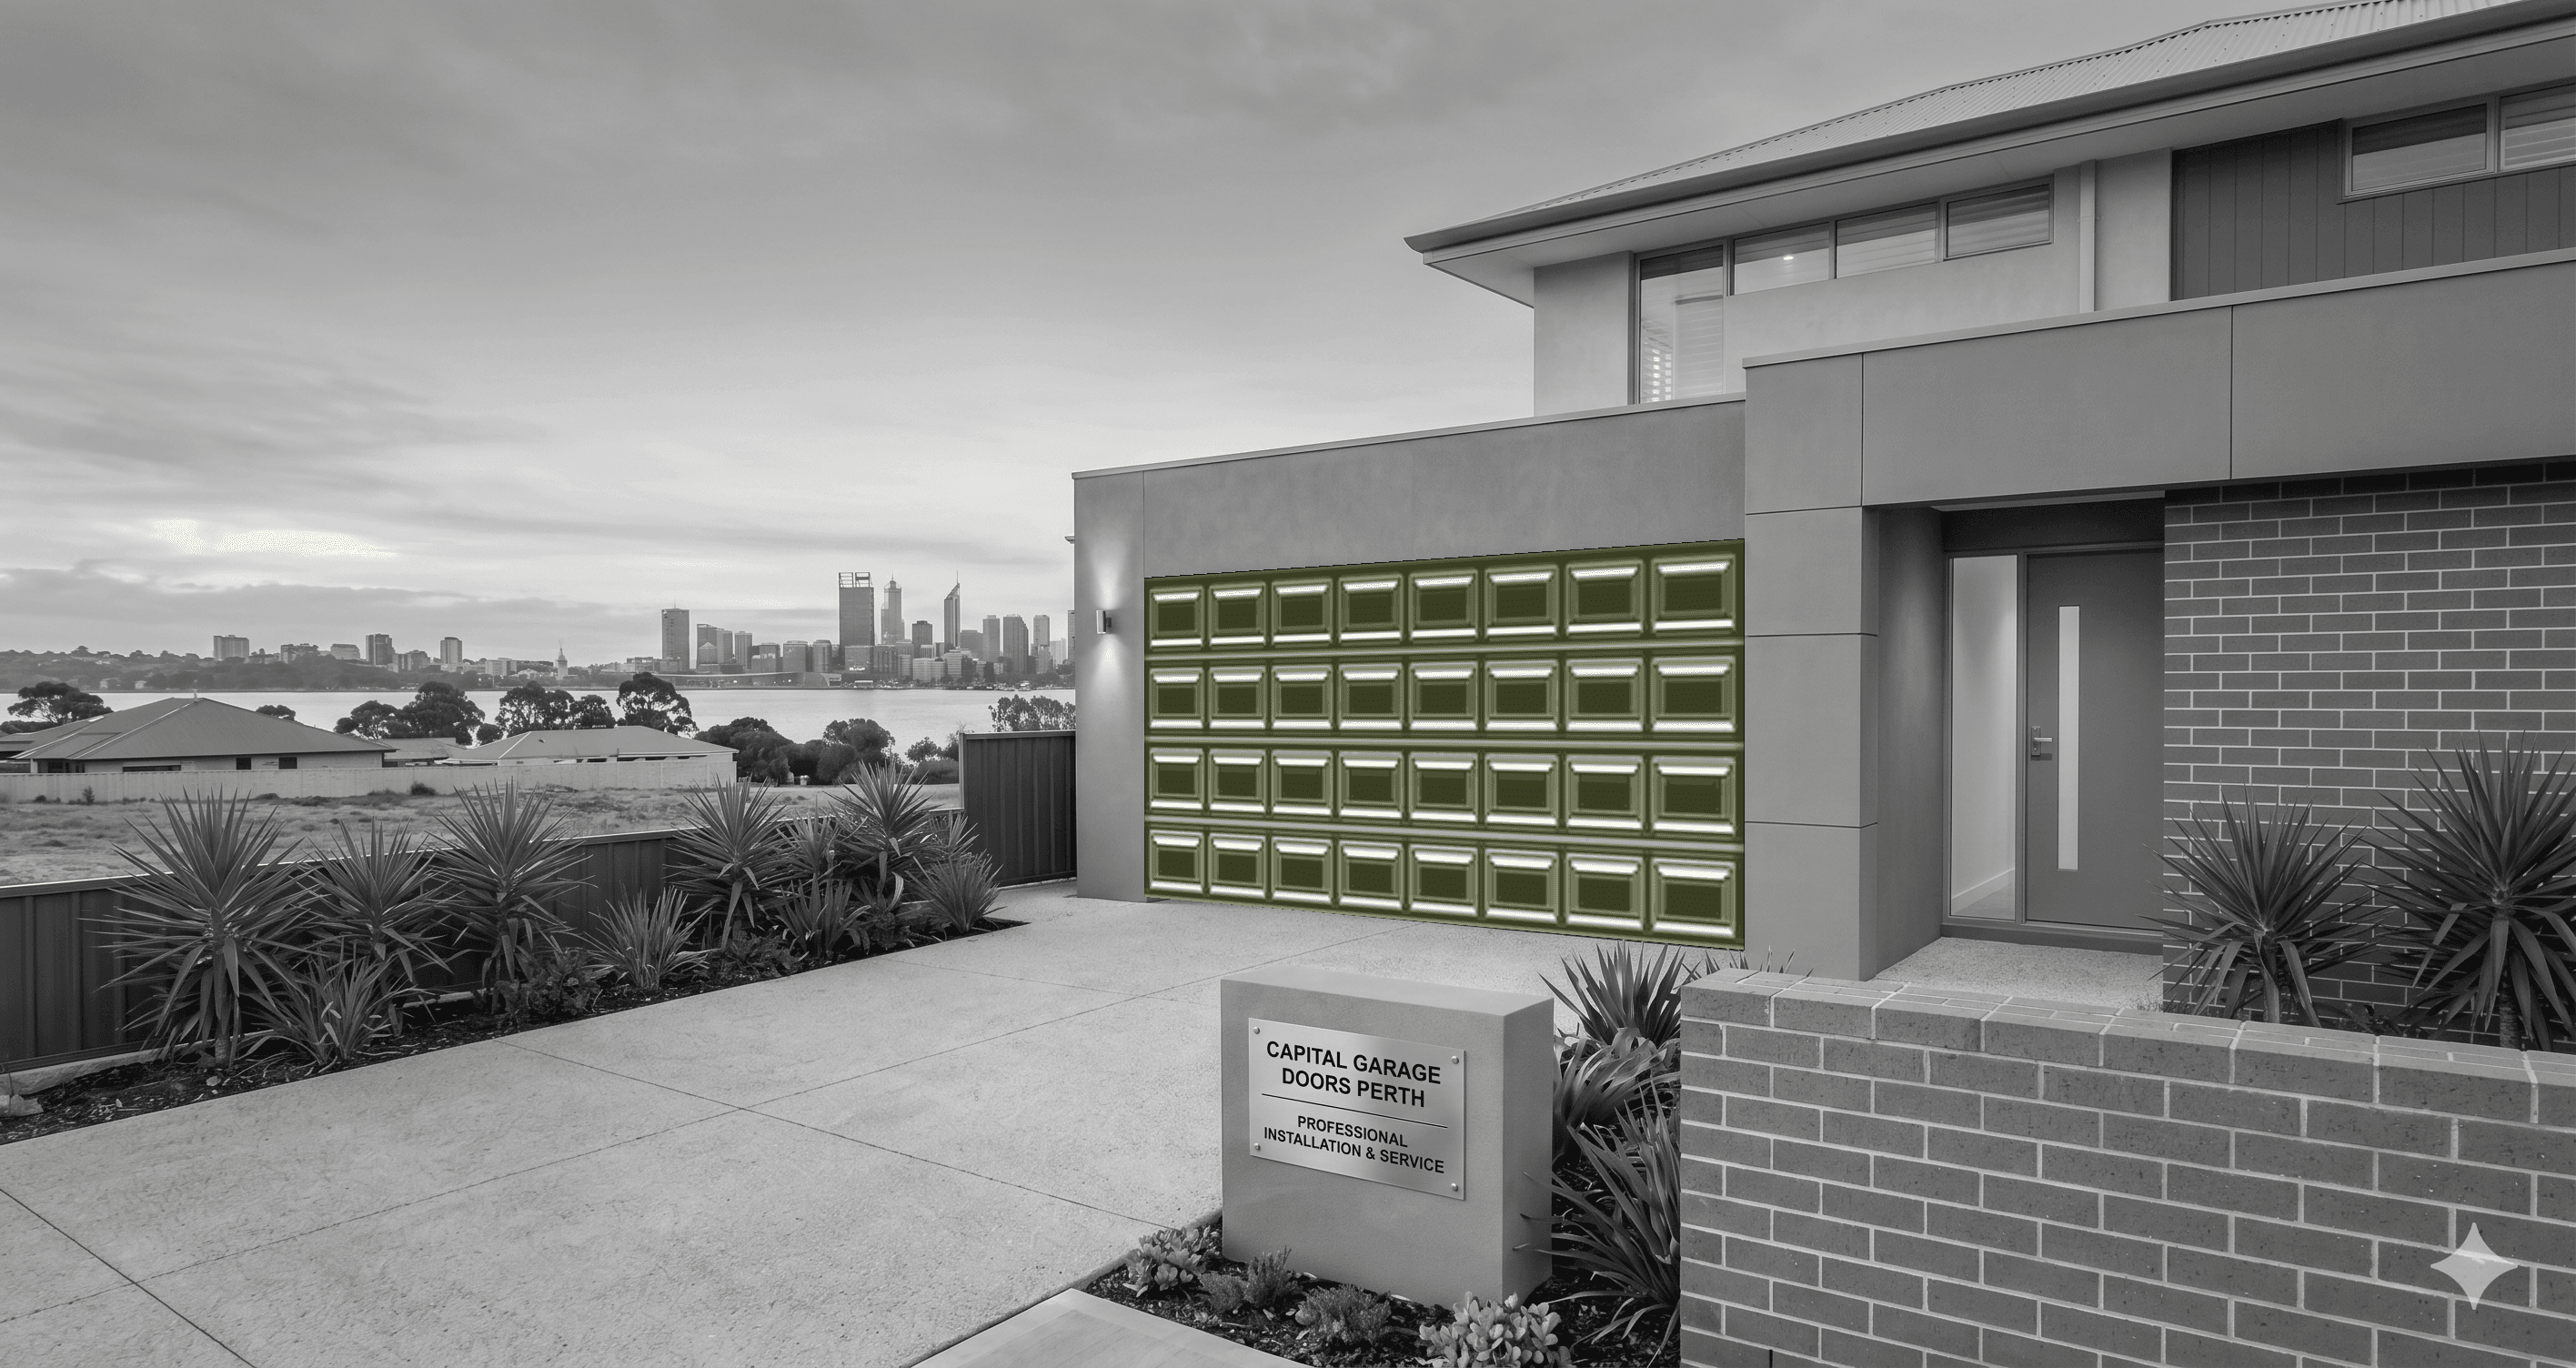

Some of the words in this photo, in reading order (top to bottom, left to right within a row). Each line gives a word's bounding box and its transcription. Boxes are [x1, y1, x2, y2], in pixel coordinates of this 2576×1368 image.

[1266, 1041, 1348, 1070] CAPITAL
[1353, 1054, 1441, 1085] GARAGE
[1282, 1067, 1351, 1095] DOORS
[1357, 1080, 1424, 1108] PERTH
[1264, 1126, 1362, 1158] INSTALLATION
[1365, 1146, 1375, 1161] &
[1380, 1149, 1444, 1174] SERVICE
[1297, 1115, 1409, 1148] PROFESSIONAL
